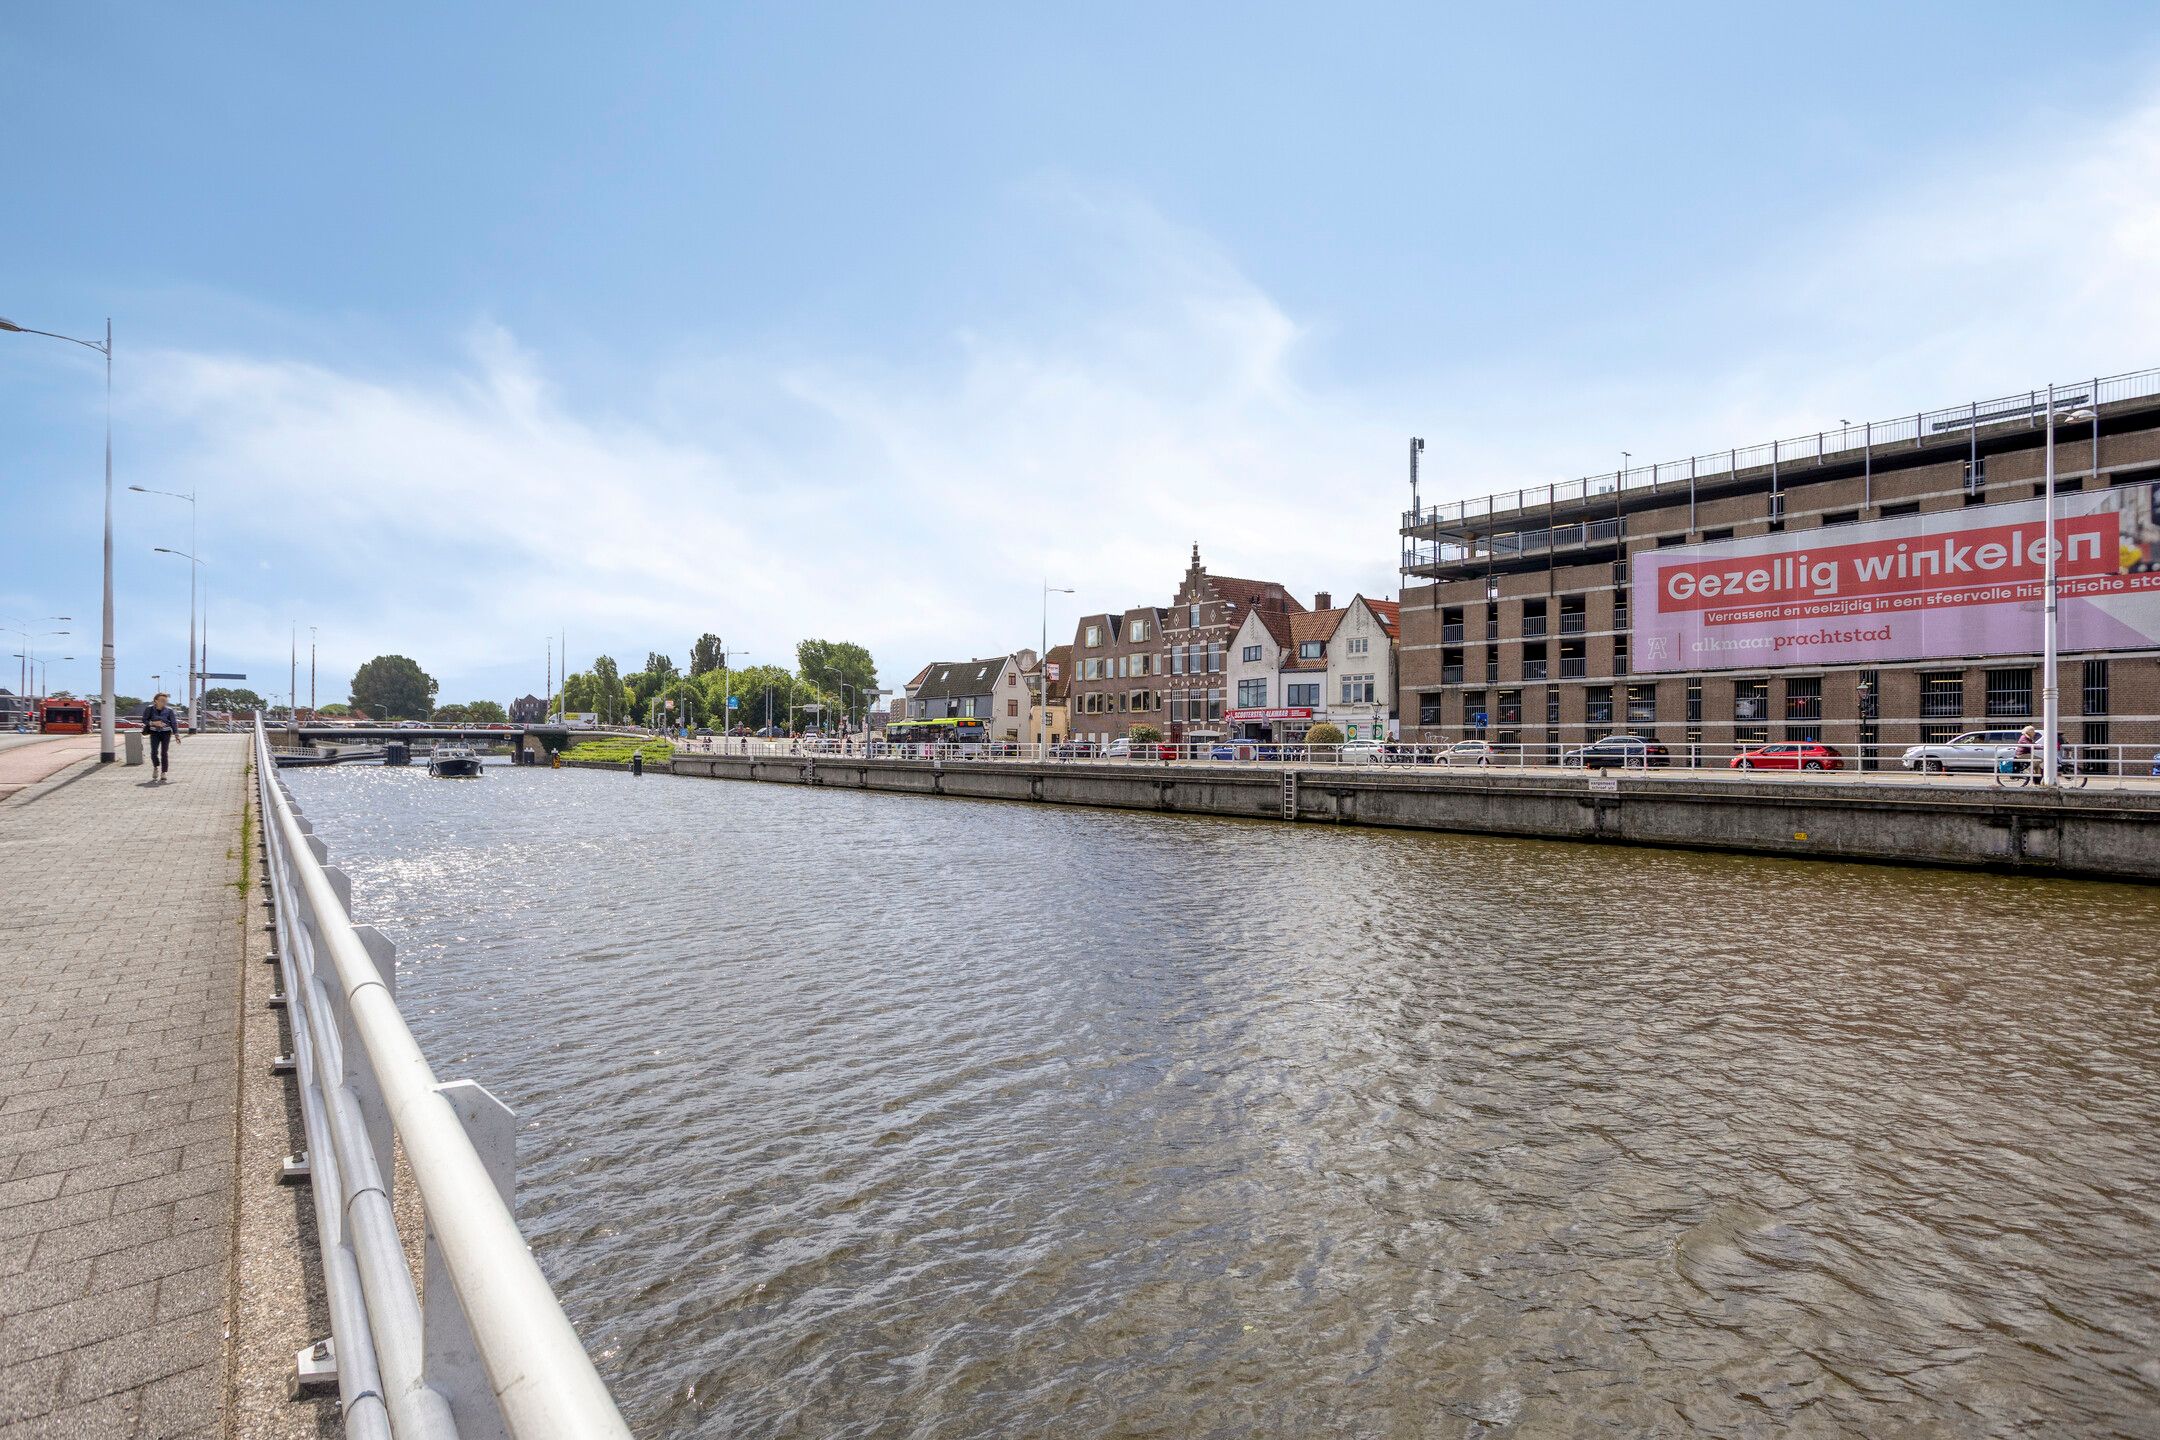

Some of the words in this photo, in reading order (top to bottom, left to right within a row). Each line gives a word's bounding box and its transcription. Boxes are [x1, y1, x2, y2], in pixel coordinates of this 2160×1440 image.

[1668, 555, 1838, 600] Gezellig
[1853, 530, 2101, 582] winkelen
[1708, 606, 1780, 622] Verrassend
[1783, 607, 1800, 616] en
[1804, 599, 1872, 614] veelzijdig
[1876, 598, 1889, 609] in
[1893, 596, 1922, 608] een
[1927, 587, 2011, 604] sfeervolle
[2017, 579, 2124, 597] hisorische
